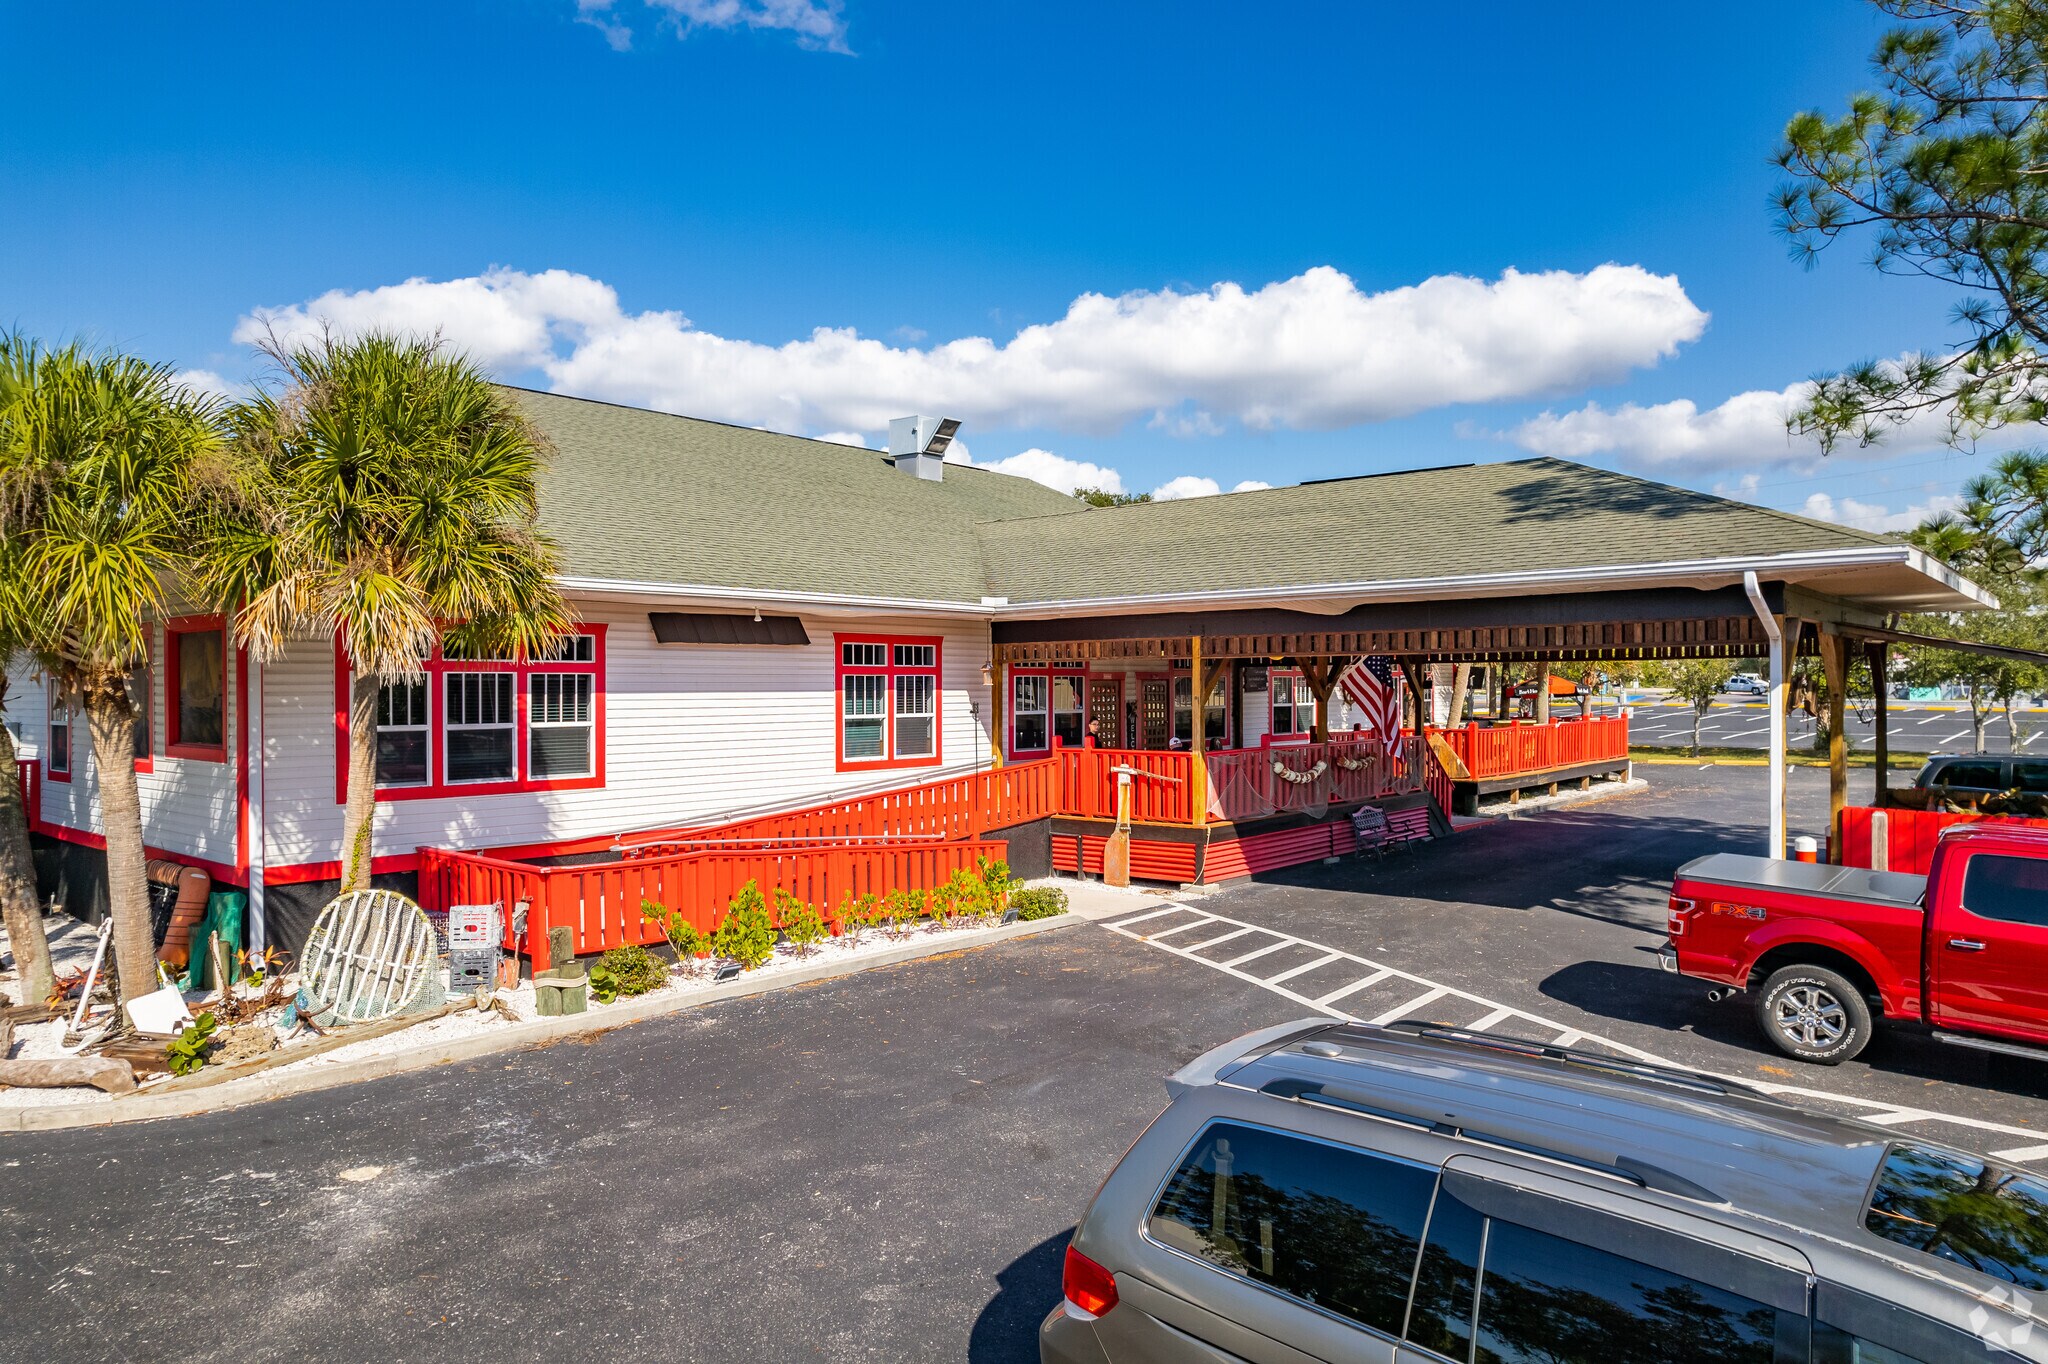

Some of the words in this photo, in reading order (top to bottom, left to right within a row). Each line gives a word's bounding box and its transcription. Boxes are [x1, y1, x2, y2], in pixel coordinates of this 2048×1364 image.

[1711, 902, 1766, 921] FX4
[1765, 977, 1826, 1010] GOODYEAR
[1794, 1027, 1857, 1058] WRANGLER
